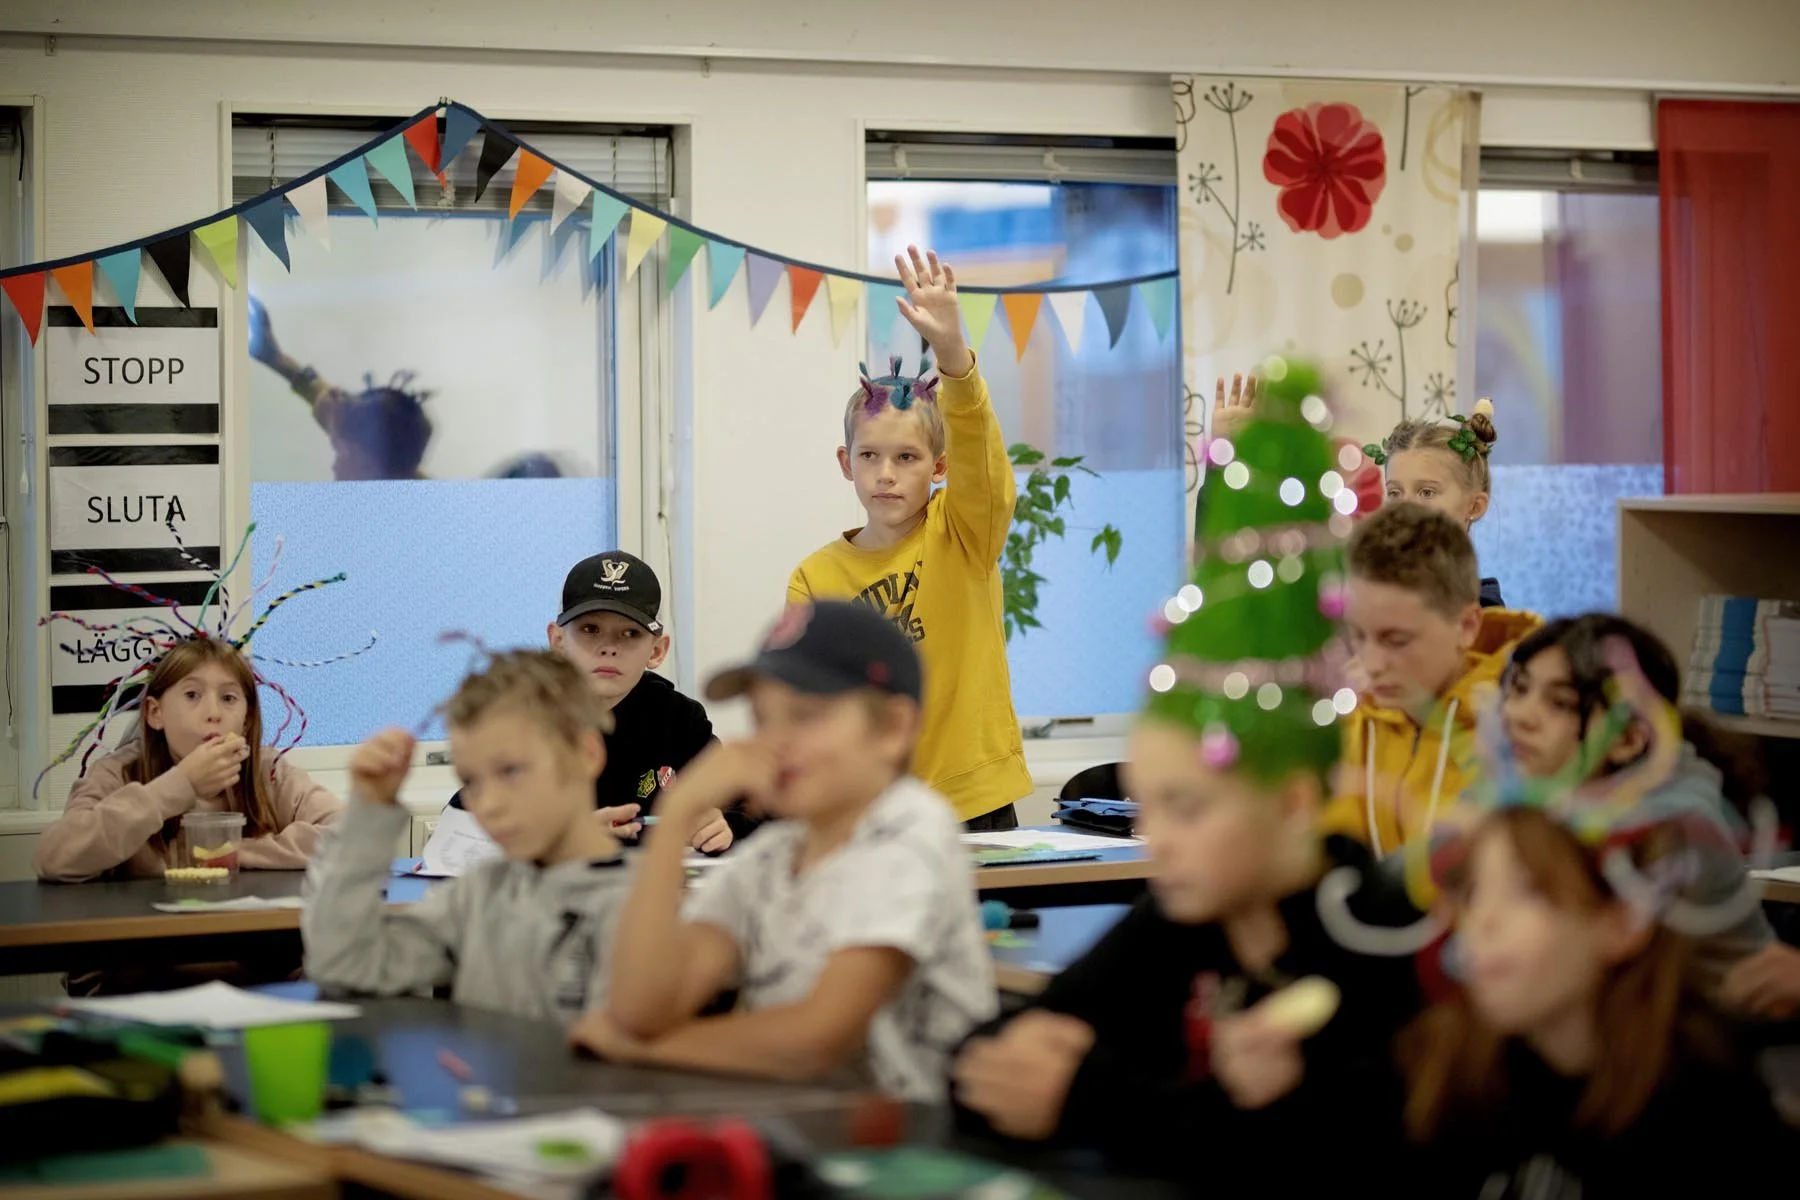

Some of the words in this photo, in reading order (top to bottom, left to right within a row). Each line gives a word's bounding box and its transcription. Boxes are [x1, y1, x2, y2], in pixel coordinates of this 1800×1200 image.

[84, 357, 185, 385] STOPP
[87, 495, 186, 523] SLUTA
[76, 632, 152, 664] LÄGG
